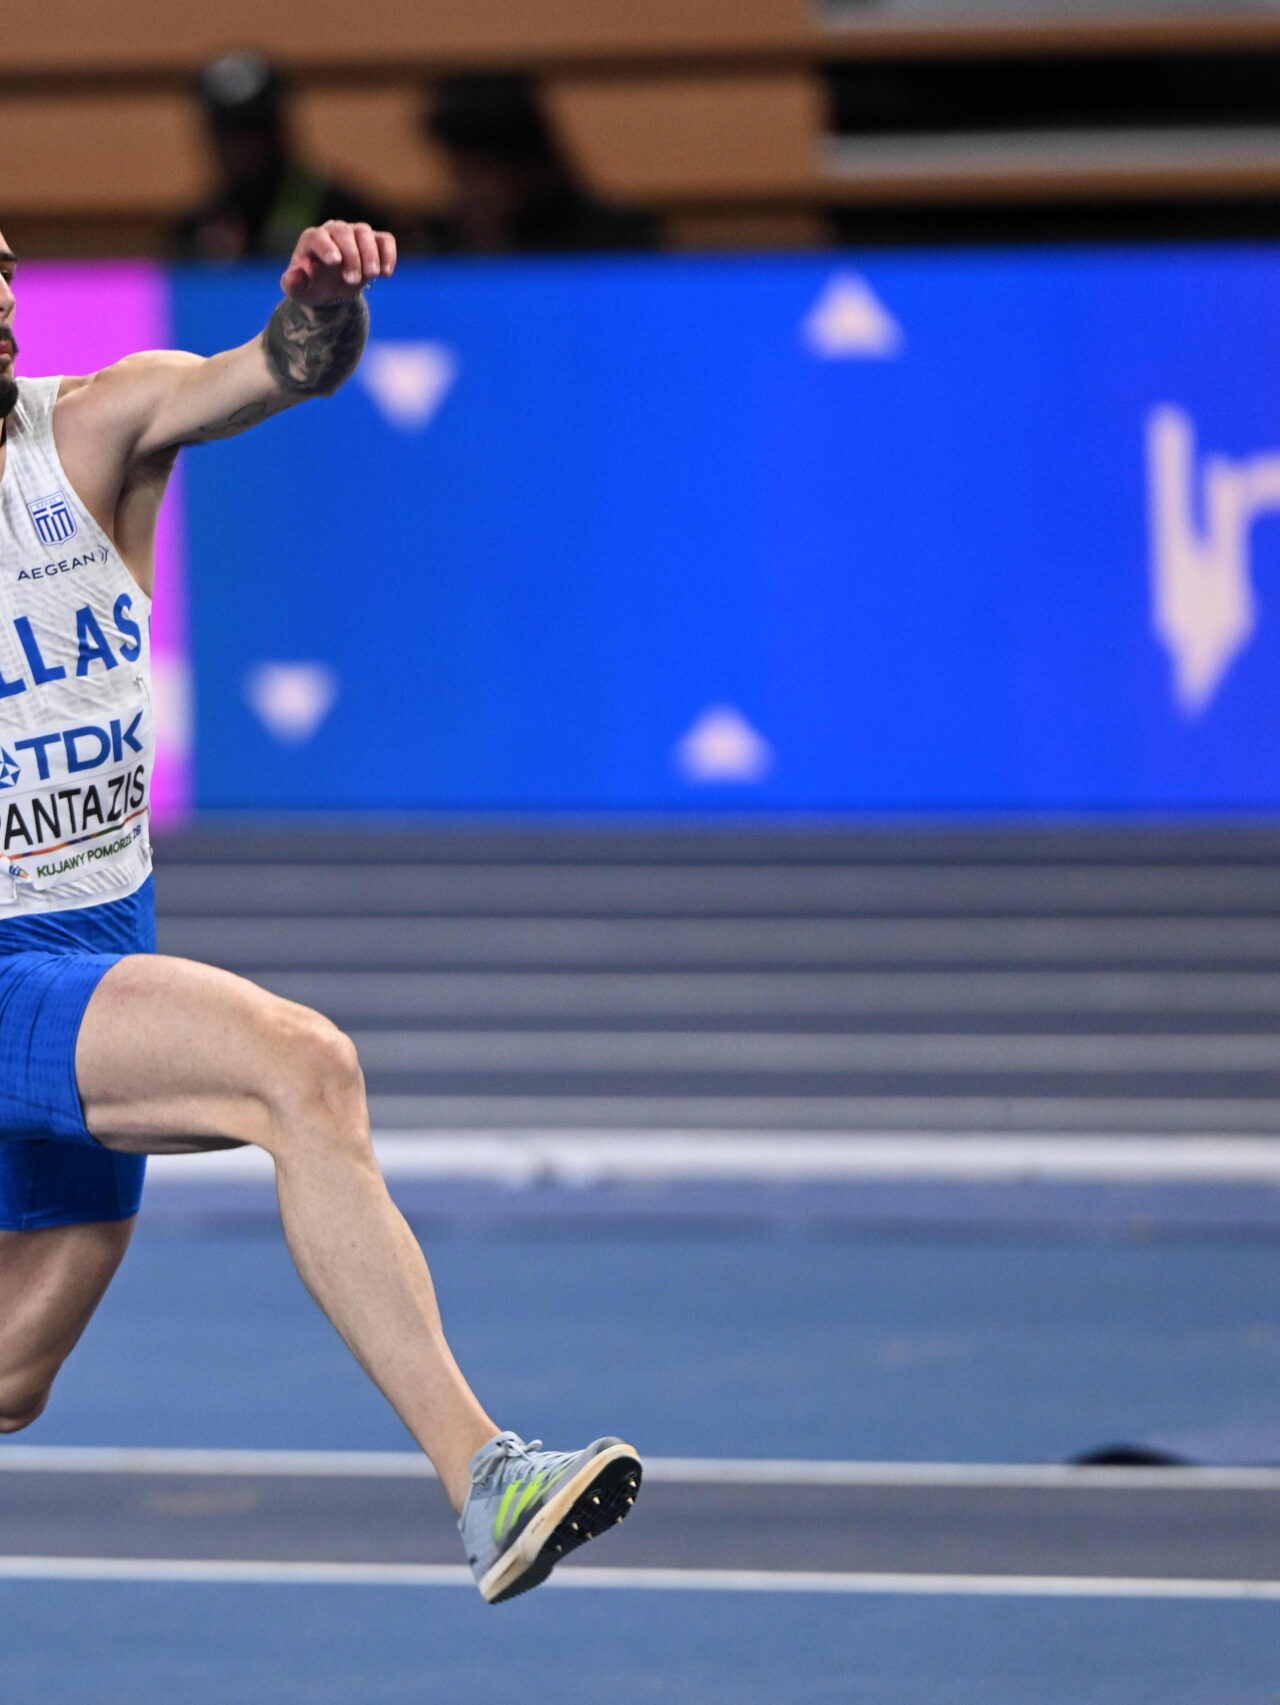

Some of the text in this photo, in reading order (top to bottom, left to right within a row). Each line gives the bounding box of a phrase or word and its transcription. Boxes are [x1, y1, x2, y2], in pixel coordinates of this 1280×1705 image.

[17, 551, 96, 581] AEGEAN
[14, 709, 144, 781] TDK
[37, 854, 86, 878] KUJAWY
[87, 833, 132, 862] POMORZE
